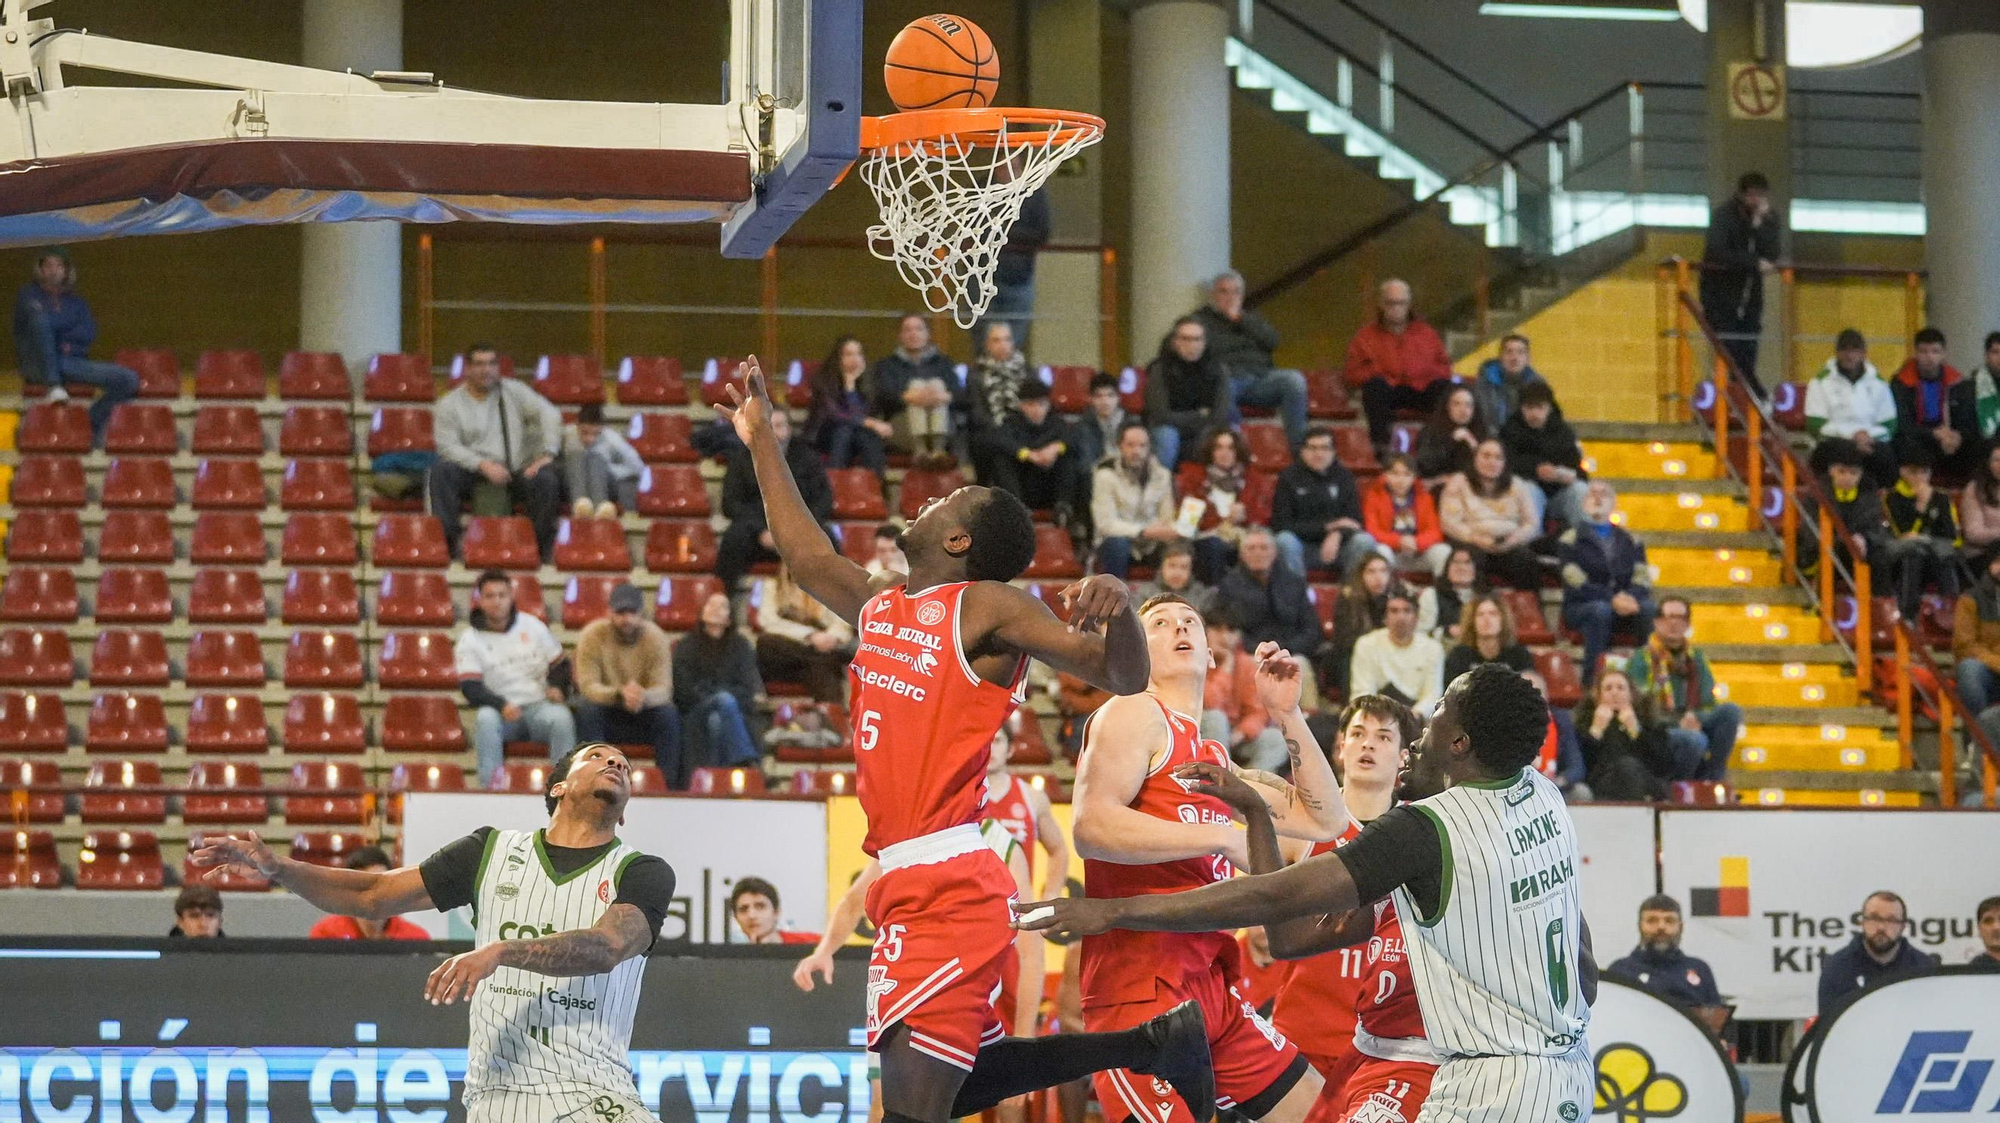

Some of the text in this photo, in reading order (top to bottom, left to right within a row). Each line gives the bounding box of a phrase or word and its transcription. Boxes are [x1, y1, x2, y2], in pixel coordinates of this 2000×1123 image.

[895, 627, 944, 651] RURAL
[1505, 809, 1562, 857] LAMINE
[1763, 911, 1846, 939] The
[1339, 948, 1363, 979] 11
[1381, 952, 1401, 963] LEÓN
[489, 983, 538, 999] Fundación
[308, 1022, 451, 1123] de
